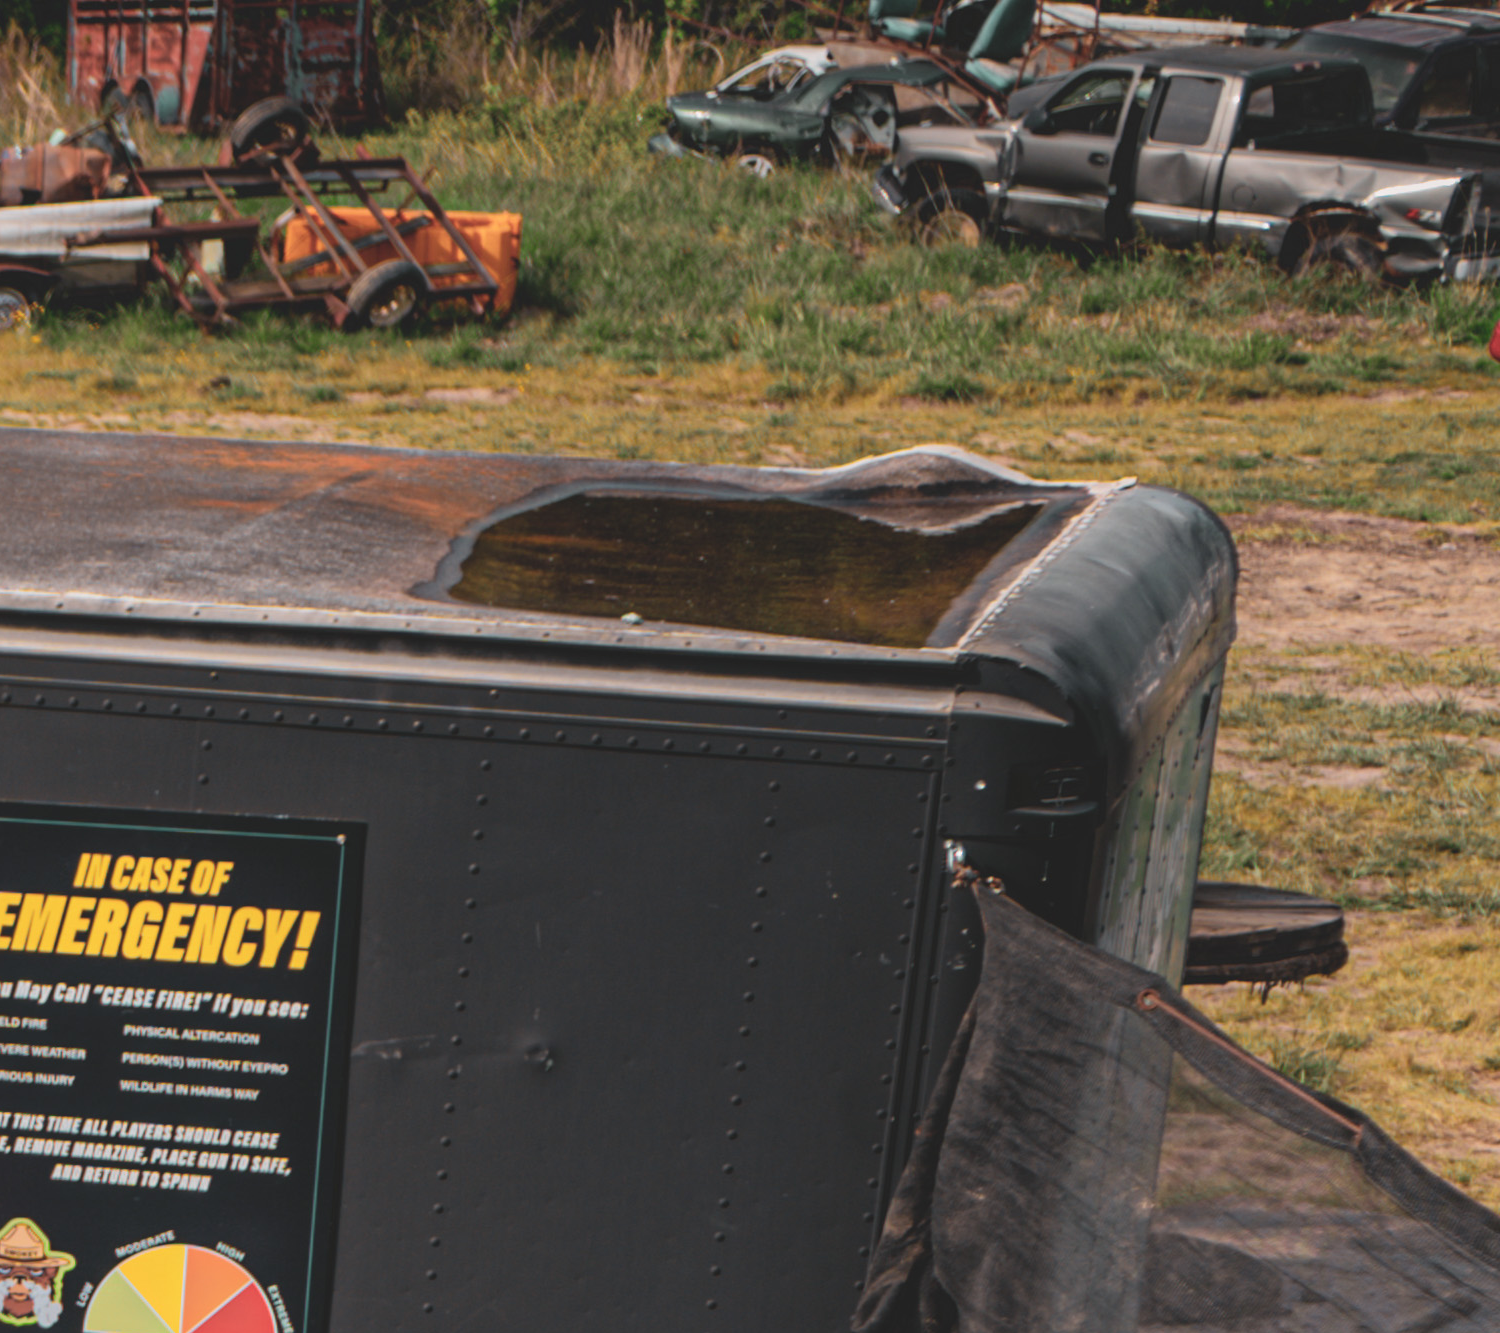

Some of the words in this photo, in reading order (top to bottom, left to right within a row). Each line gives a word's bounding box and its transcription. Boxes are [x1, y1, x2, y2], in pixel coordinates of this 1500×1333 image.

[73, 853, 111, 889] IN
[111, 855, 191, 894] CASE
[190, 860, 234, 896] OF
[15, 980, 51, 1004] May
[53, 983, 91, 1003] Call
[229, 996, 265, 1018] you
[268, 1000, 309, 1019] see:
[21, 1017, 47, 1030] FIRE
[124, 1025, 180, 1040] PHYSICAL
[182, 1028, 260, 1045] ALTERCATION
[31, 1045, 86, 1060] WEATHER
[122, 1052, 184, 1069] PERSON(S)
[186, 1057, 240, 1072] WITHOUT
[241, 1061, 288, 1075] EYEPRO
[35, 1072, 75, 1086] INJURY
[120, 1080, 174, 1095] WILDLIFE
[175, 1083, 189, 1096] IN
[190, 1084, 233, 1099] HARMS
[234, 1088, 259, 1101] WAY
[12, 1113, 45, 1132] THIS
[47, 1115, 81, 1133] TIME
[81, 1119, 108, 1136] ALL
[110, 1120, 172, 1141] PLAYERS
[174, 1126, 231, 1146] SHOULD
[232, 1130, 279, 1150] CEASE
[13, 1137, 70, 1157] REMOVE
[71, 1141, 148, 1165] MAGAZINE,
[151, 1150, 196, 1167] PLACE
[197, 1152, 229, 1169] GUN
[230, 1155, 249, 1171] TO
[250, 1157, 292, 1176] SAFE,
[51, 1164, 82, 1182] AND
[83, 1166, 138, 1187] RETURN
[140, 1170, 160, 1188] TO
[160, 1173, 211, 1192] SPAWN
[115, 1230, 175, 1258] MODERATE
[216, 1241, 245, 1262] HIGH
[76, 1282, 94, 1307] LOW
